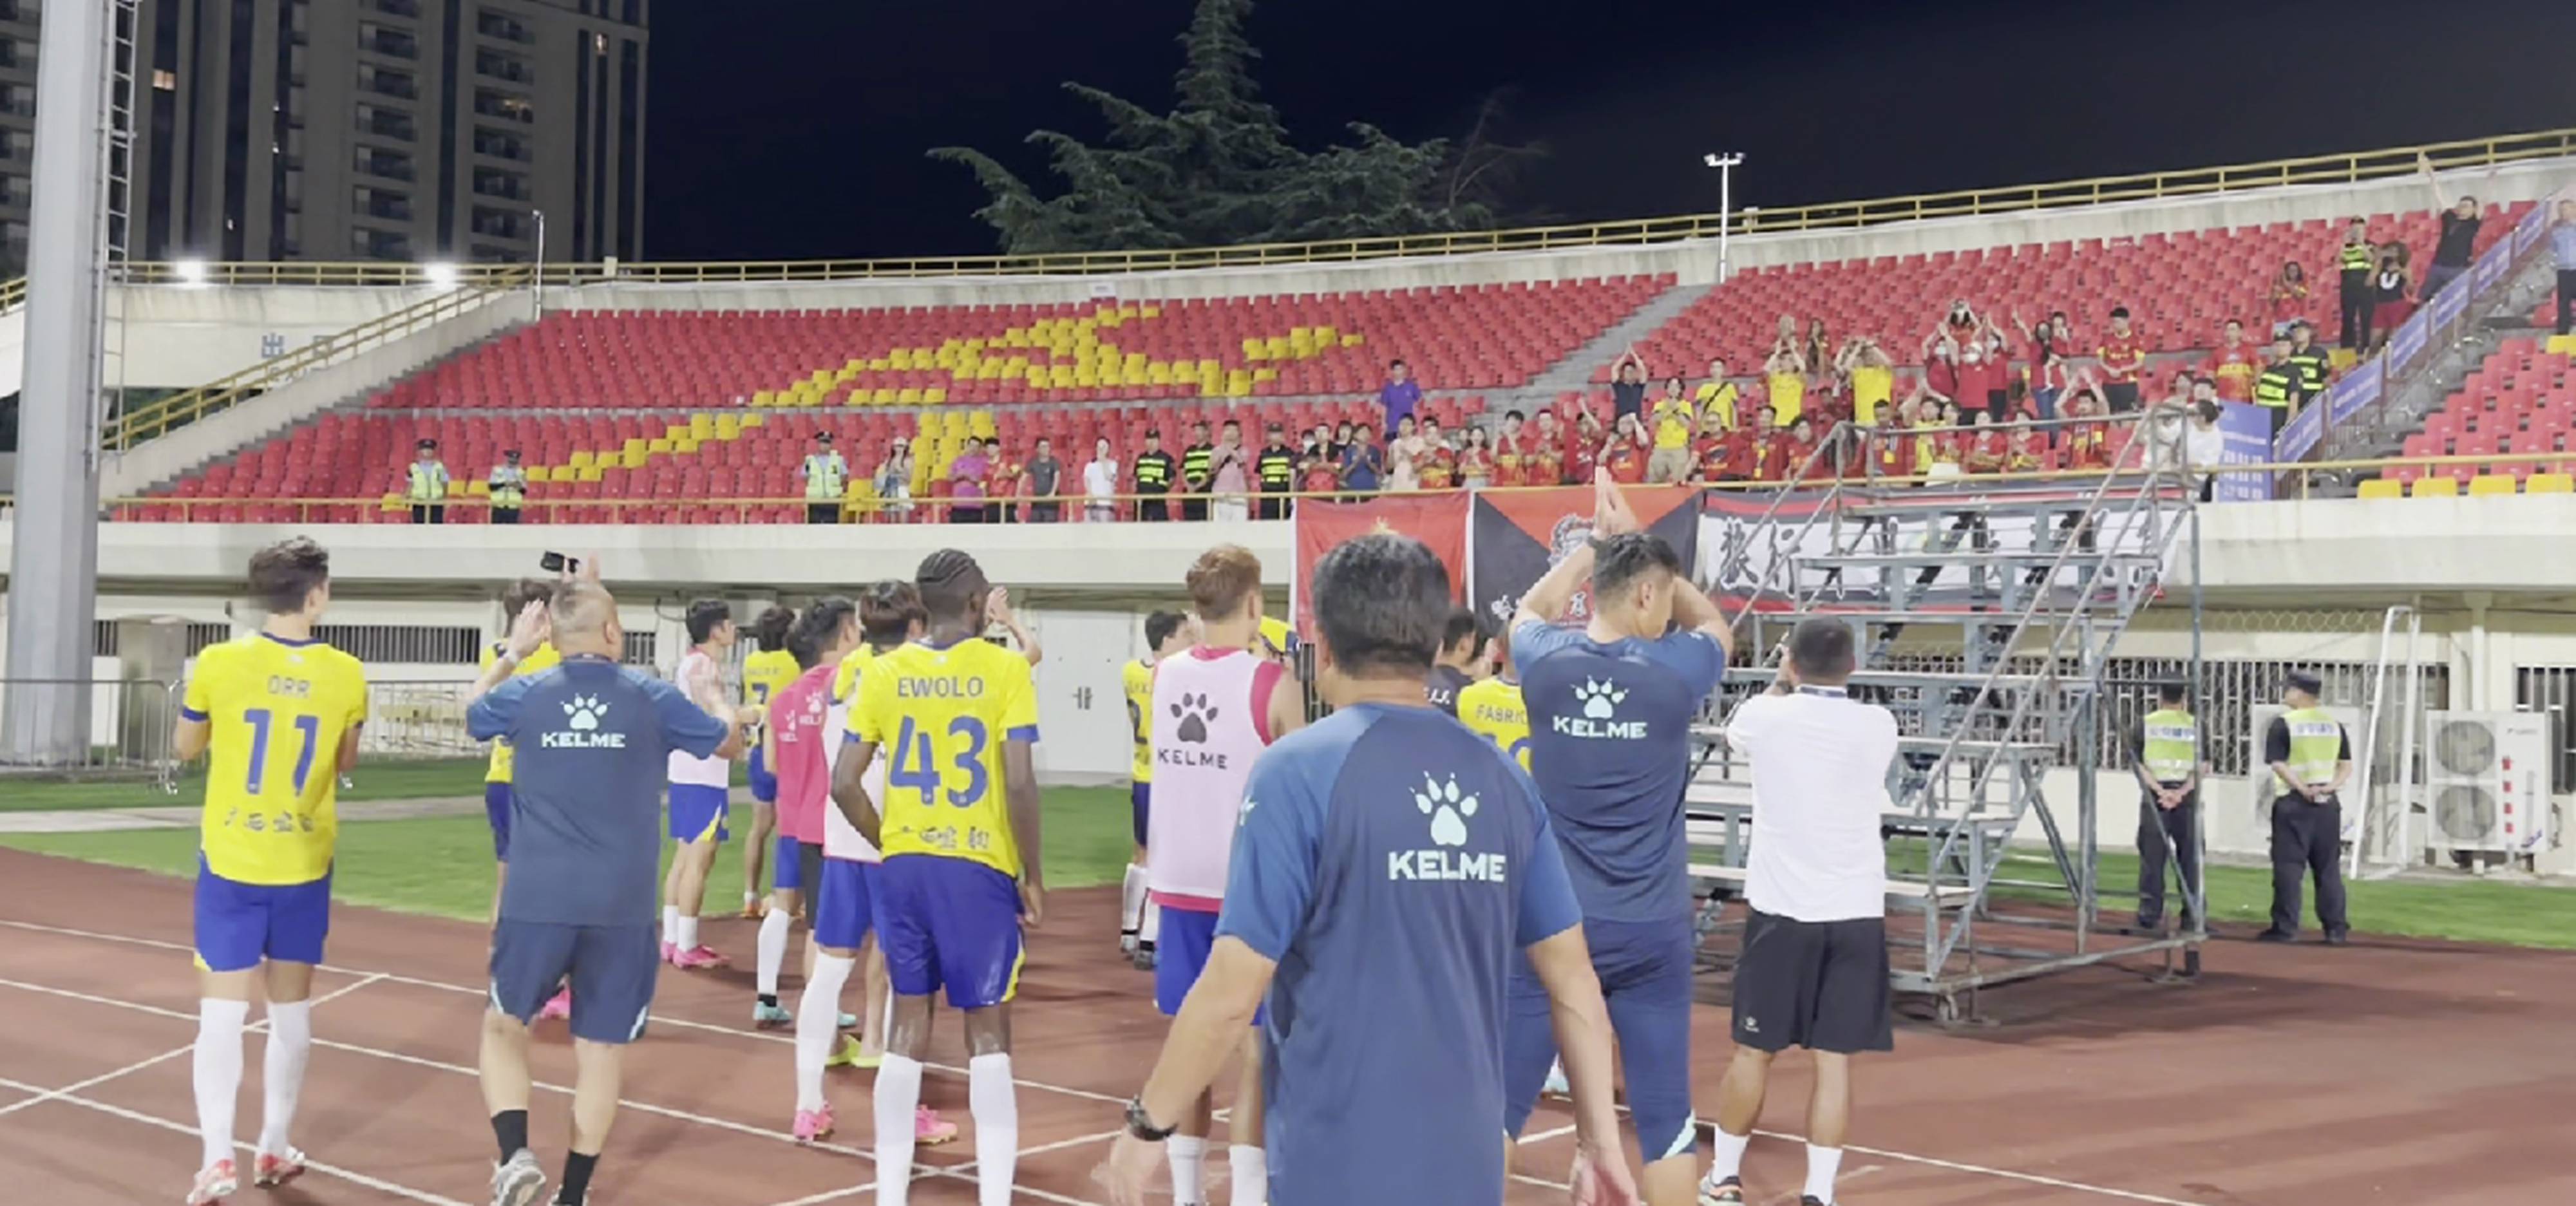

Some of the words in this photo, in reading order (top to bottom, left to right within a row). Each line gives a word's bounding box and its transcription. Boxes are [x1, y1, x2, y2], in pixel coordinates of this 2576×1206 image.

[267, 675, 310, 697] ORR
[897, 676, 984, 697] EWOLO
[1553, 715, 1648, 739] KELME
[541, 732, 626, 748] KELME
[243, 708, 319, 796] 11
[889, 715, 987, 808] 43
[1158, 748, 1228, 770] KELME
[1388, 849, 1506, 882] KELME
